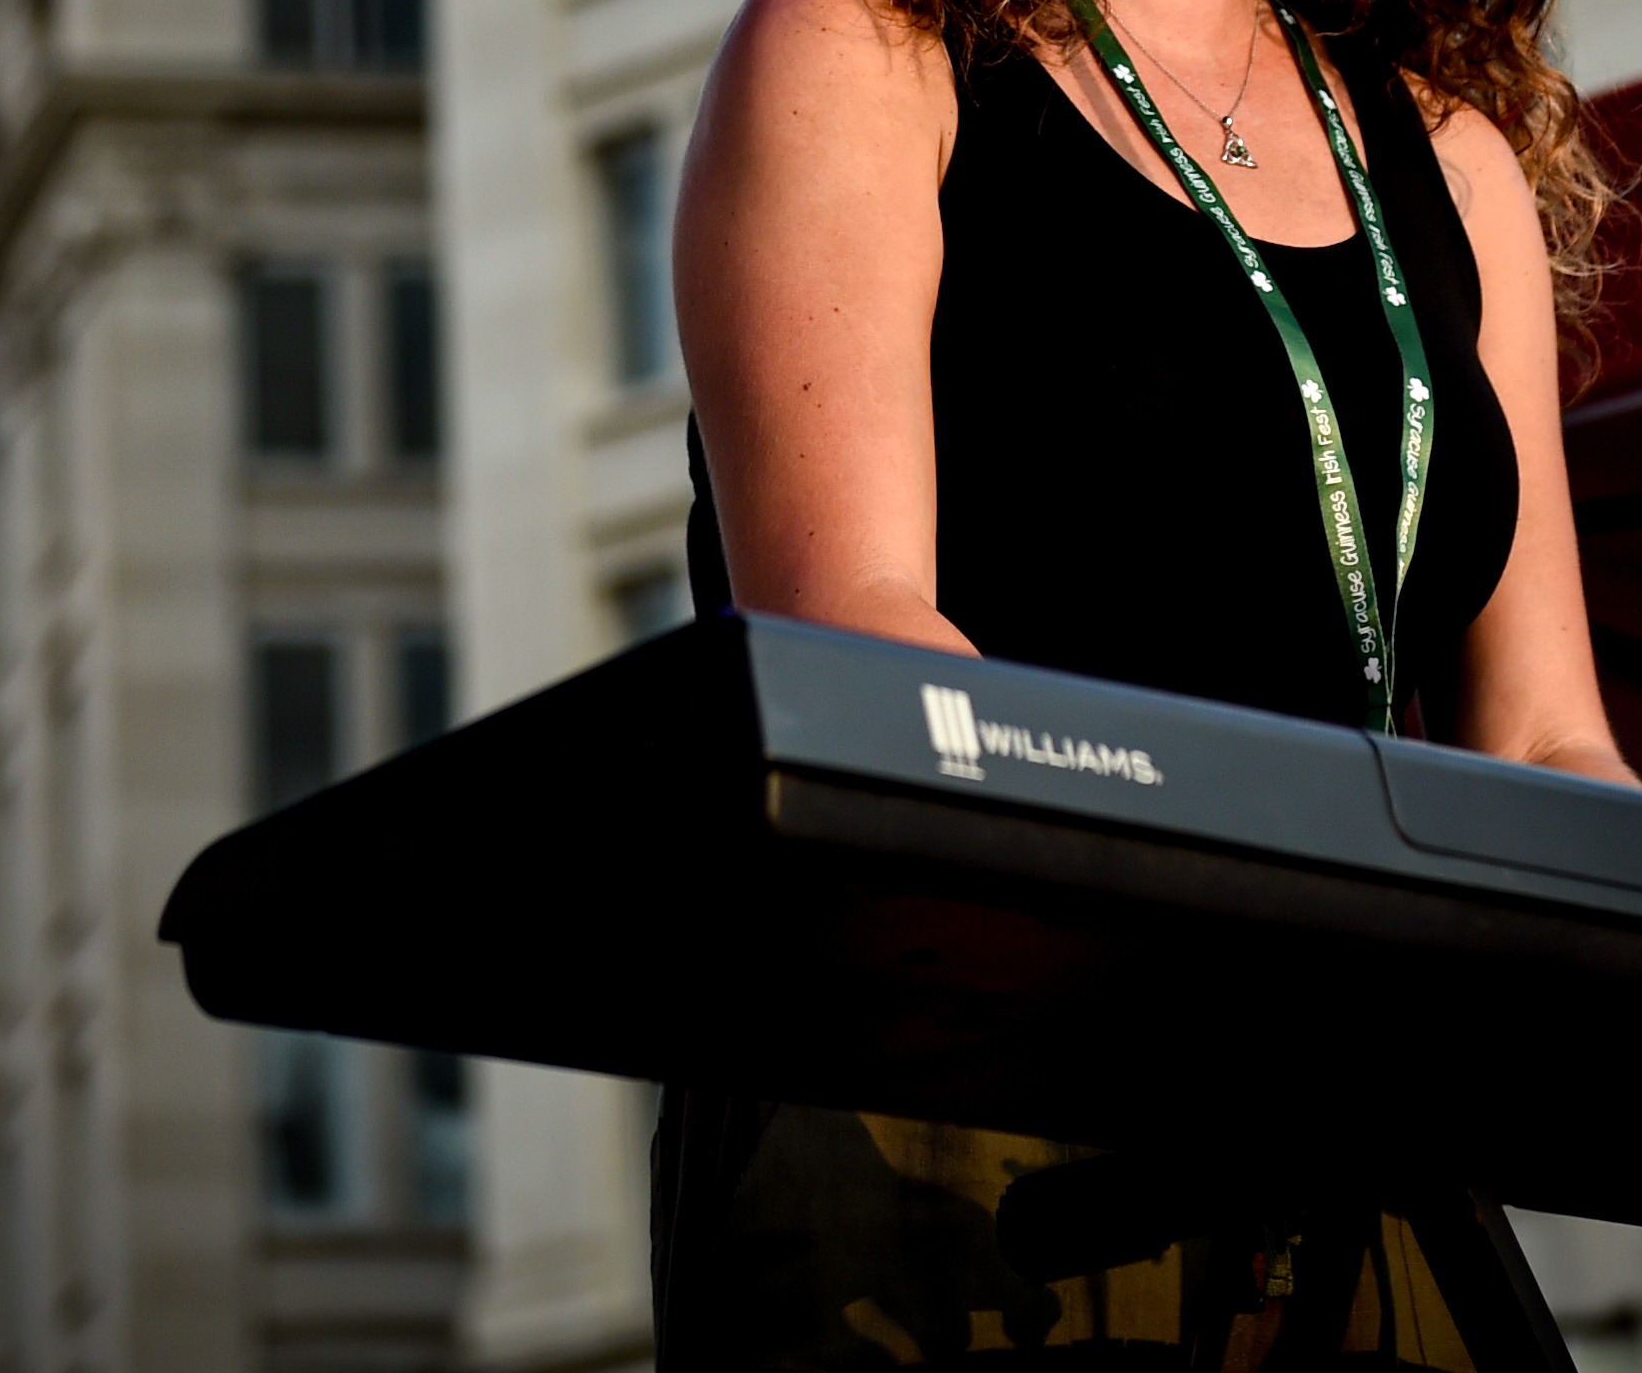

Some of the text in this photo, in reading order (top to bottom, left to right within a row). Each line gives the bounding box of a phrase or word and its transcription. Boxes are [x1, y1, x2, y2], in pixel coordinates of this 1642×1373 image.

[1126, 86, 1259, 268] Syracuse Guinness Irish Fest
[1379, 251, 1401, 285] Fest
[1406, 402, 1425, 480] Syracuse
[1310, 406, 1377, 653] Syracuse Guinness Irish Fest
[978, 719, 1156, 785] WILLIAMS
